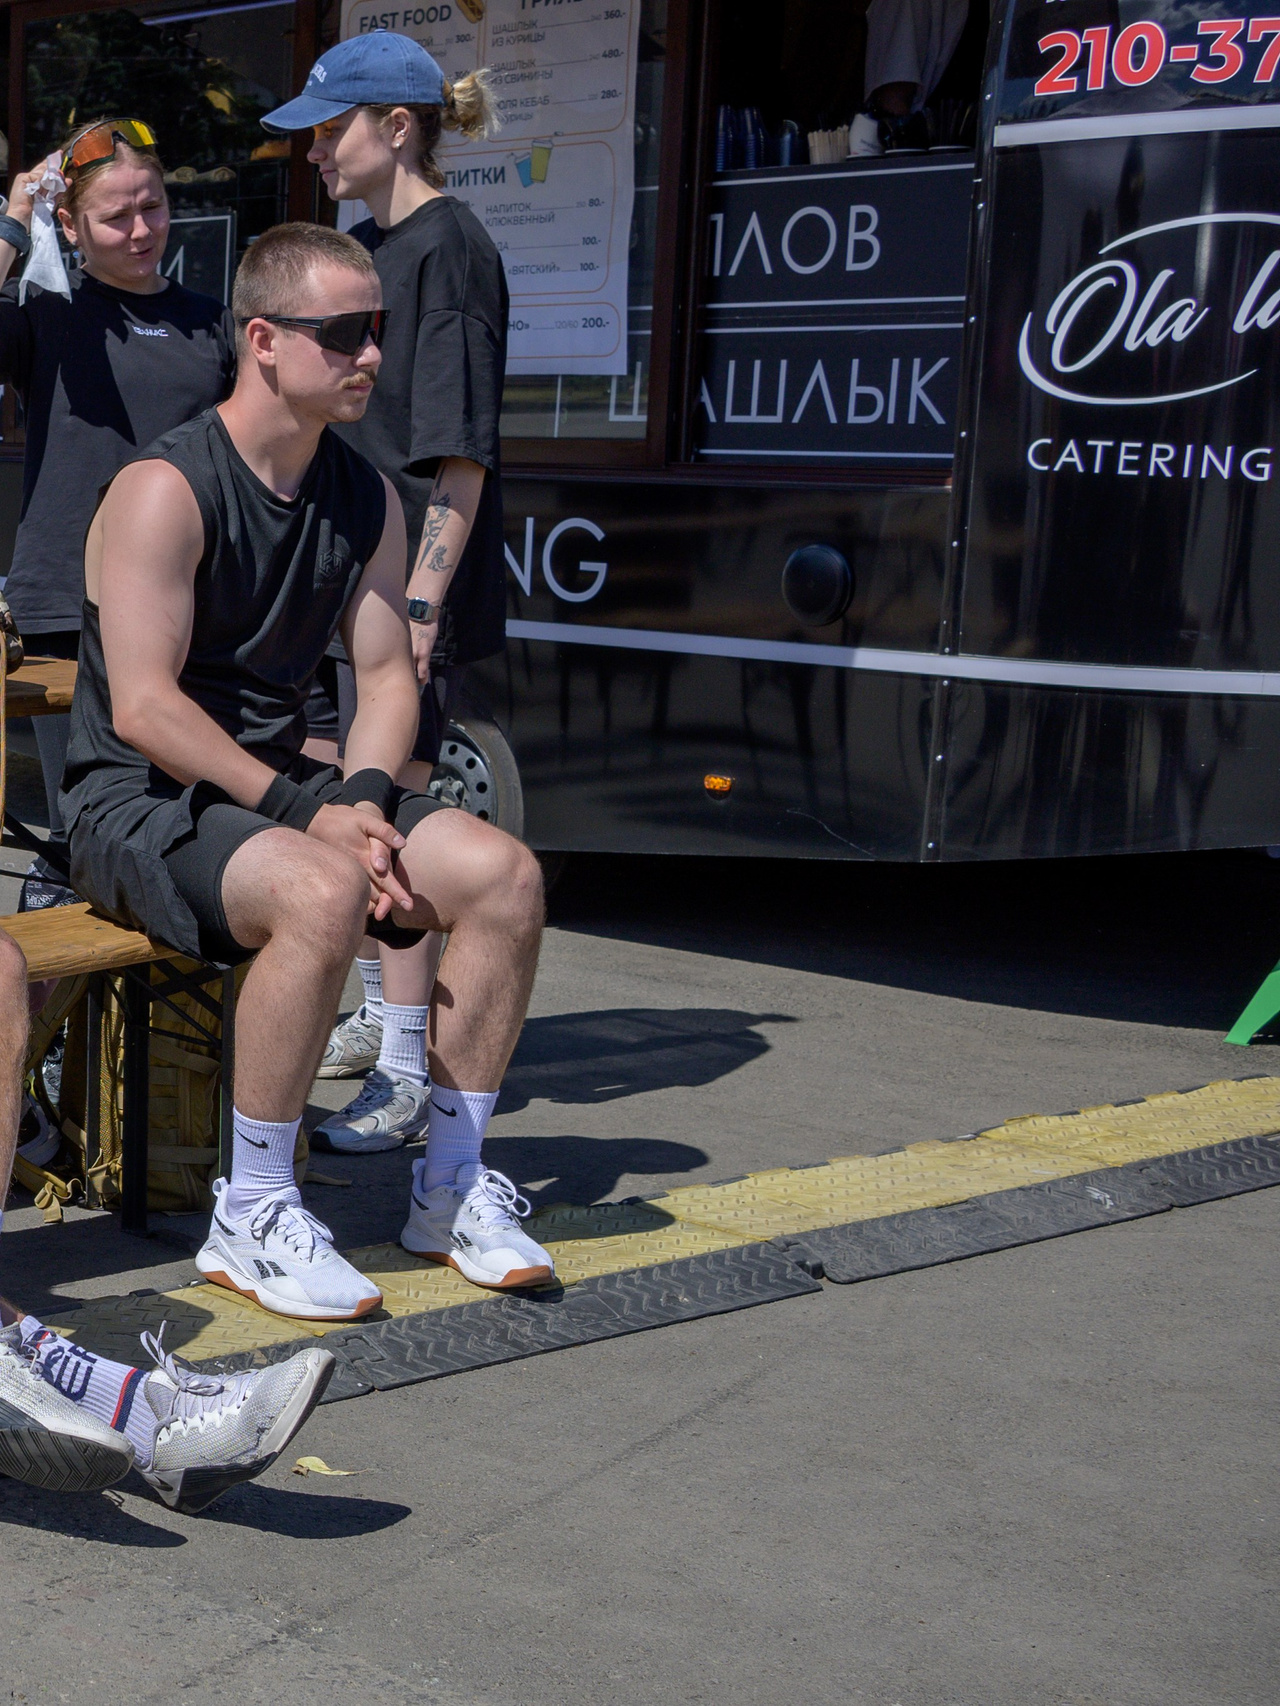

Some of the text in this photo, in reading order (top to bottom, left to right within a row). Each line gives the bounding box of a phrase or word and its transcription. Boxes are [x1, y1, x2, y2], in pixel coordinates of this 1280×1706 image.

[360, 5, 452, 33] FAST FOOD
[492, 19, 538, 35] ШАШЛЫК
[491, 32, 546, 47] ИЗ КУРИЦЫ
[504, 70, 553, 85] СВИНИНЫ
[520, 95, 550, 108] КЕБАБ
[445, 166, 506, 188] ПИТКИ
[485, 202, 532, 214] НАПИТОК
[485, 213, 555, 227] КЛЮКВЕННЫЙ
[1045, 259, 1211, 373] Ola
[1027, 438, 1273, 482] CATERING
